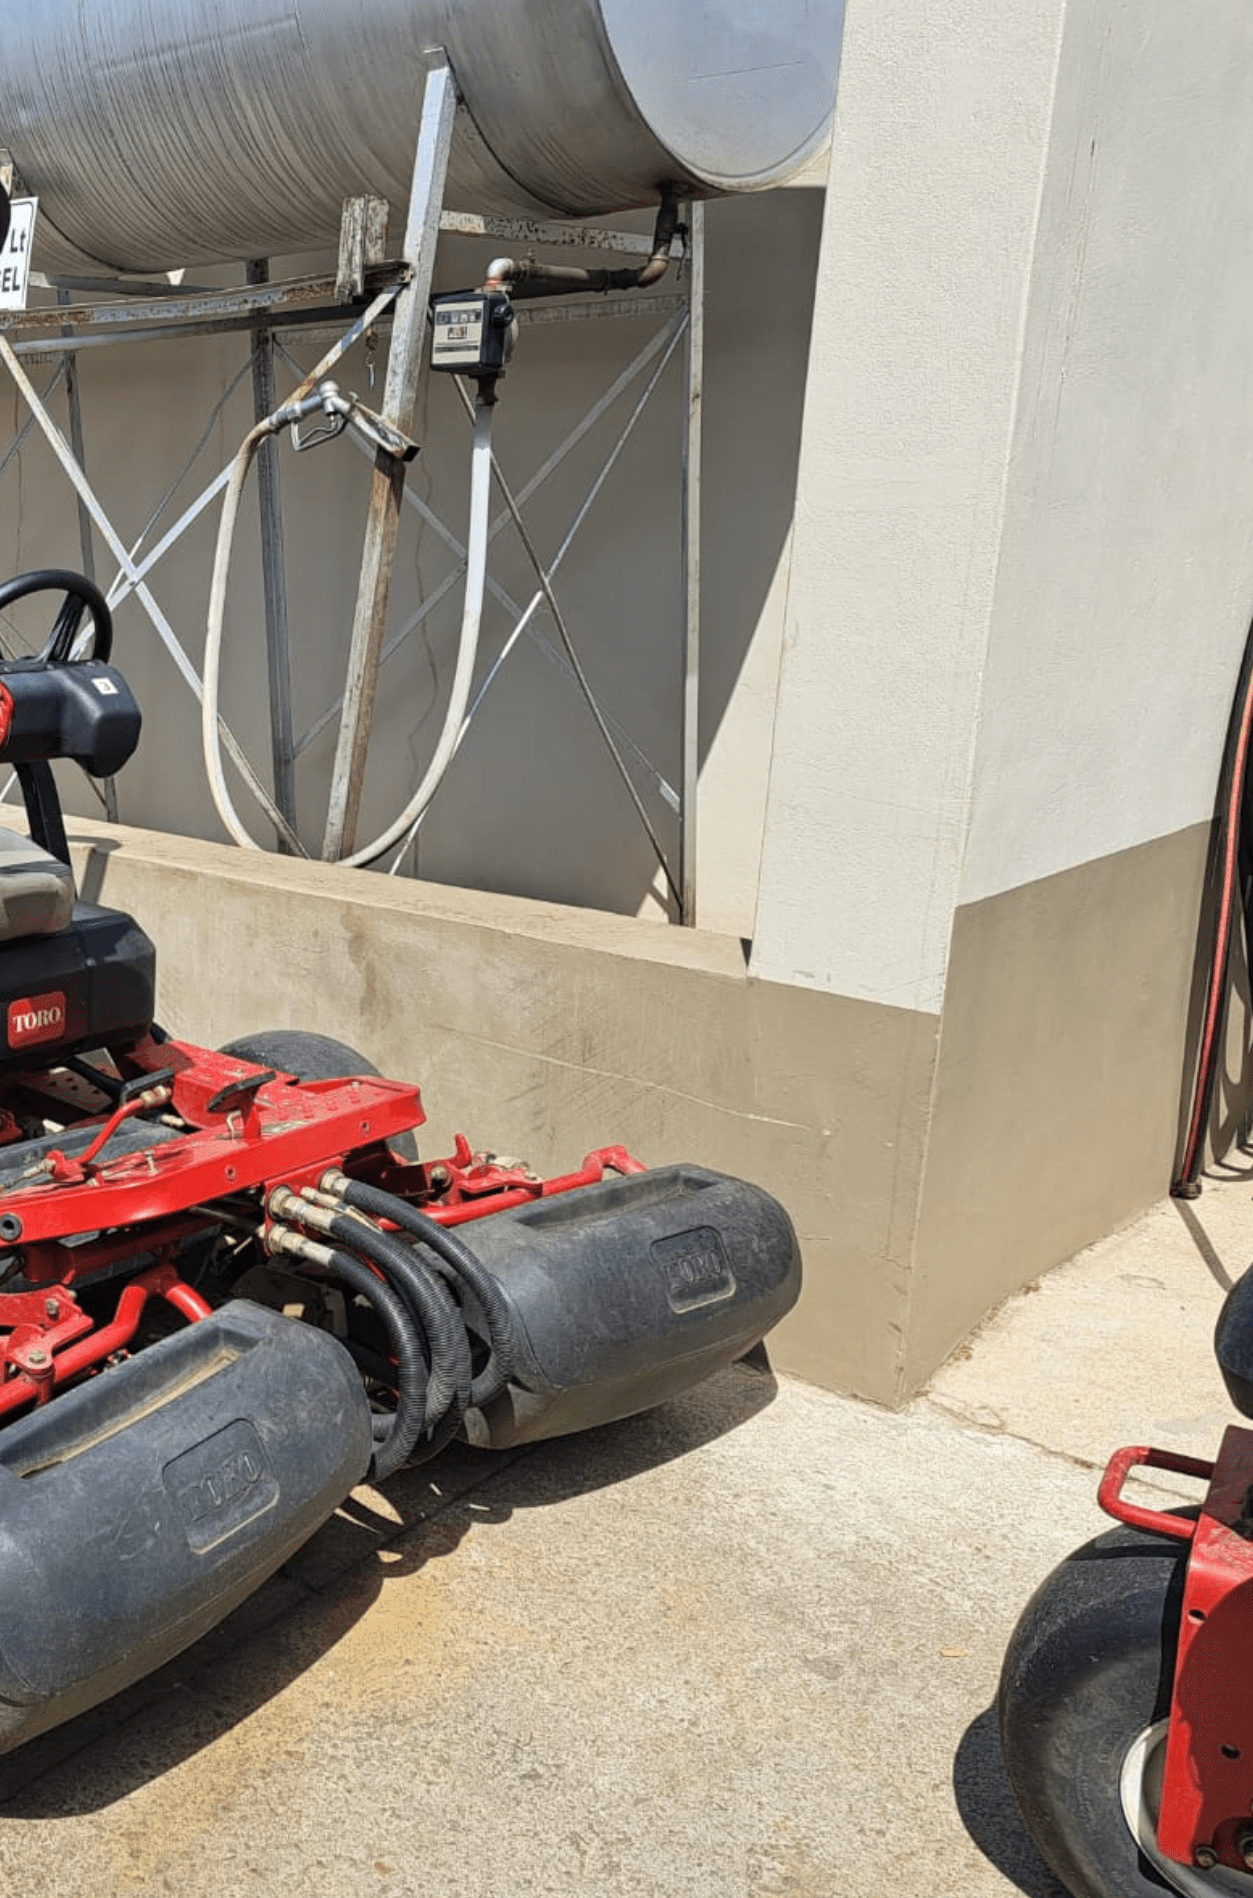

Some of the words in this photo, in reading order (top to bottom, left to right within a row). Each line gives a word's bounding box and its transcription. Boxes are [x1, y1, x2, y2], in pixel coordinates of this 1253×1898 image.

[12, 1005, 62, 1033] TORO
[662, 1249, 723, 1290] TORO
[174, 1449, 263, 1523] TORO
